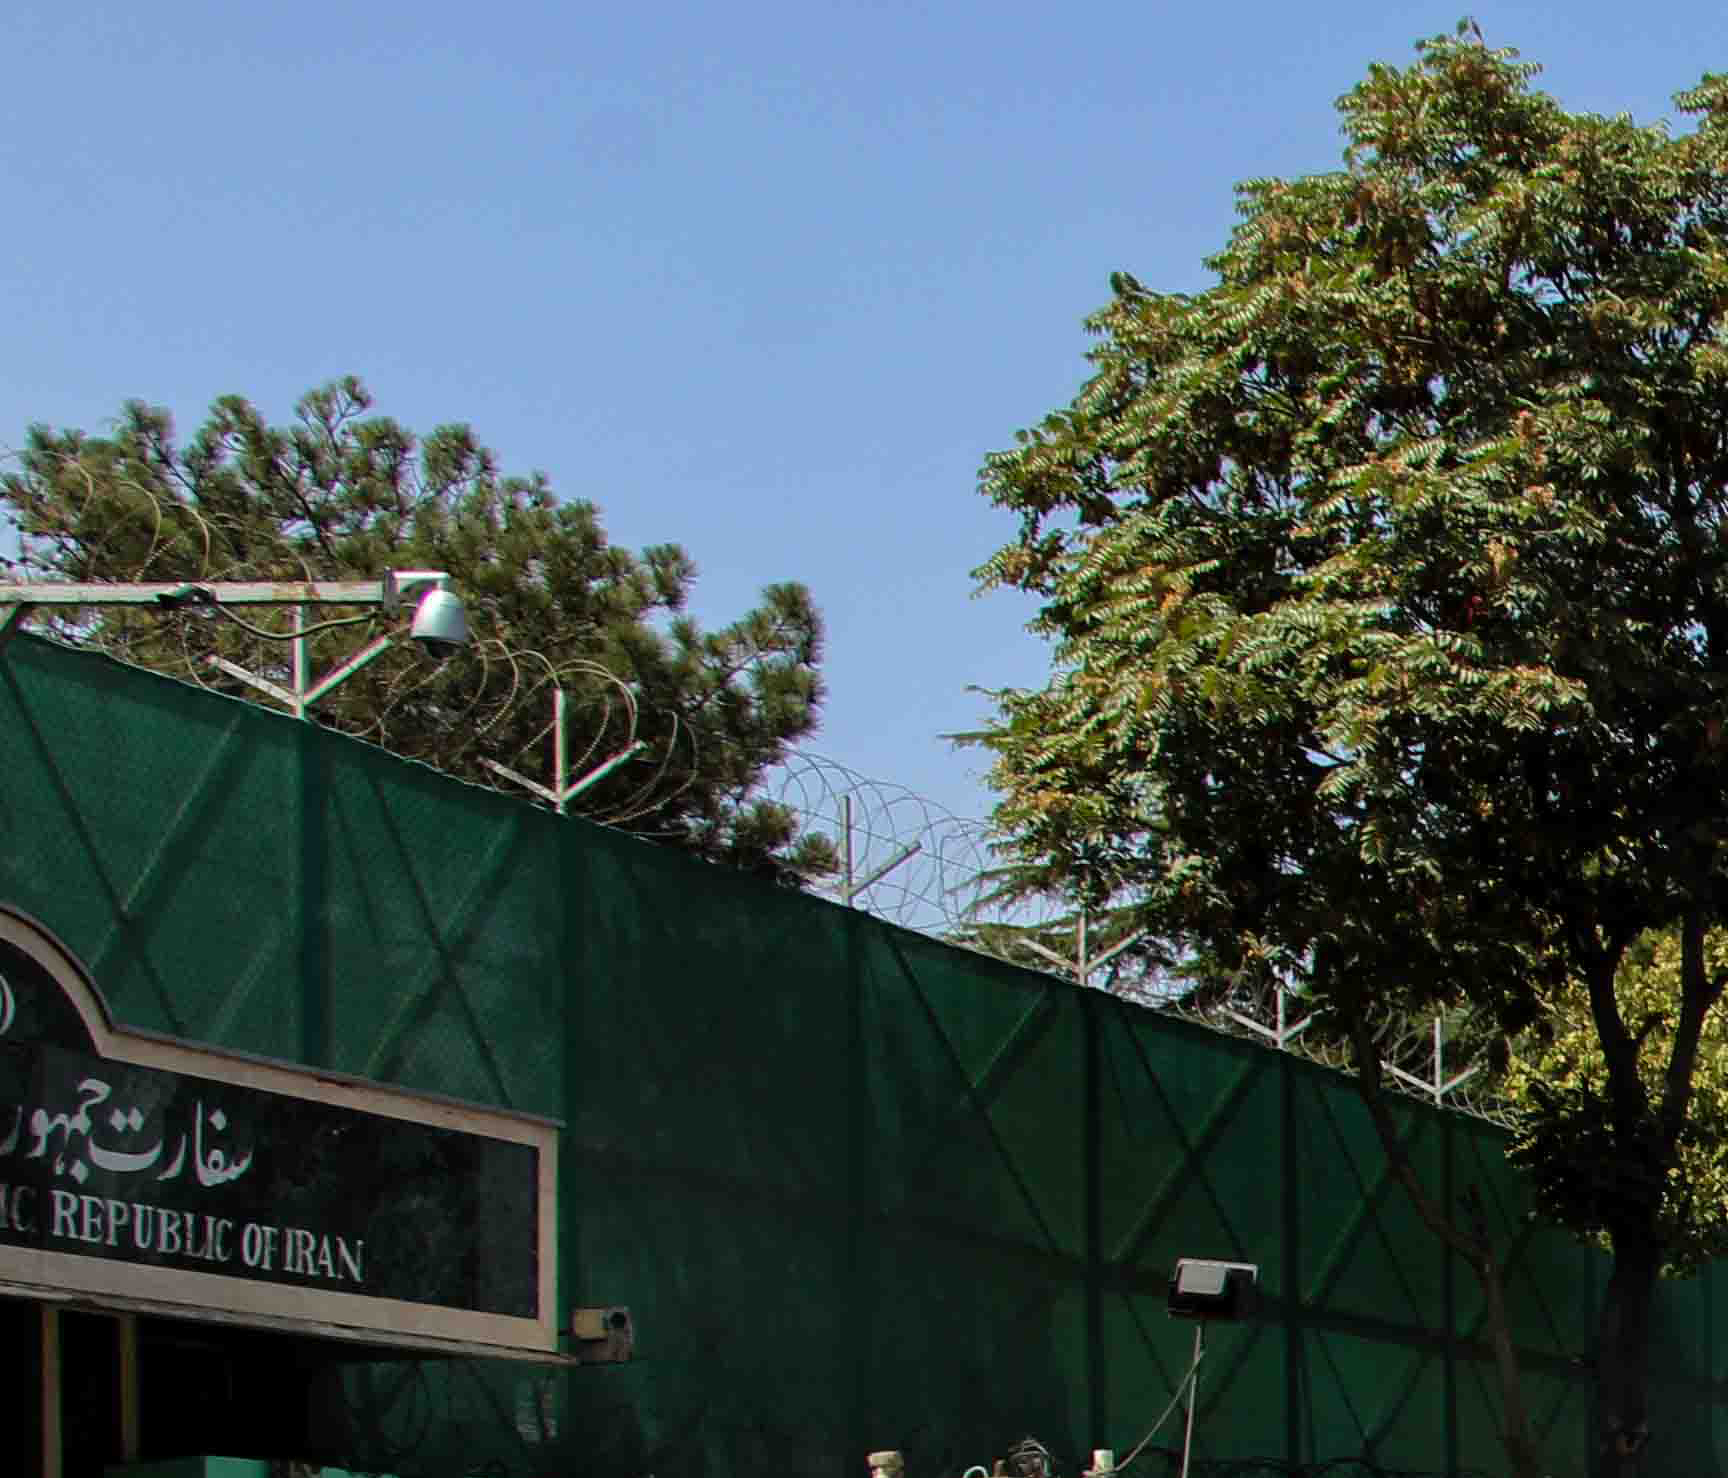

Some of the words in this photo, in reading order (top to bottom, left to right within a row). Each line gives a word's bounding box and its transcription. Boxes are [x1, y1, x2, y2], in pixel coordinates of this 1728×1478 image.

[0, 1078, 112, 1185] جمهور
[51, 1189, 233, 1263] REPUBLIC
[242, 1223, 282, 1271] OF
[283, 1227, 365, 1282] IRAN
